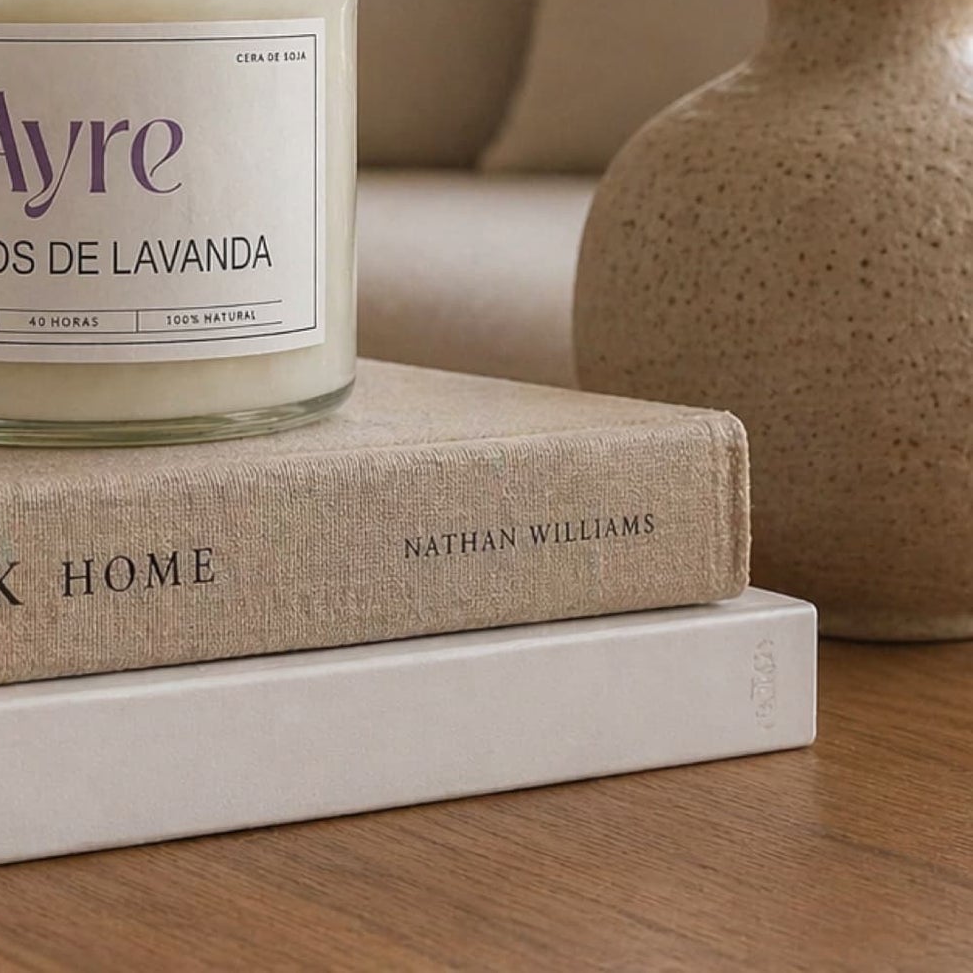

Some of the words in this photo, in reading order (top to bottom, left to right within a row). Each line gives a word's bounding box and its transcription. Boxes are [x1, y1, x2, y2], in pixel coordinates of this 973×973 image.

[236, 52, 265, 63] CERA
[267, 52, 280, 62] DE
[49, 240, 100, 276] DE
[112, 234, 273, 276] LAVANDA
[29, 316, 47, 327] 40
[50, 316, 100, 328] HORAS
[166, 314, 200, 326] 100%
[203, 310, 256, 325] NATURAL
[404, 526, 517, 559] NATHAN
[529, 513, 656, 545] WILLIAMS
[61, 547, 216, 597] HOME
